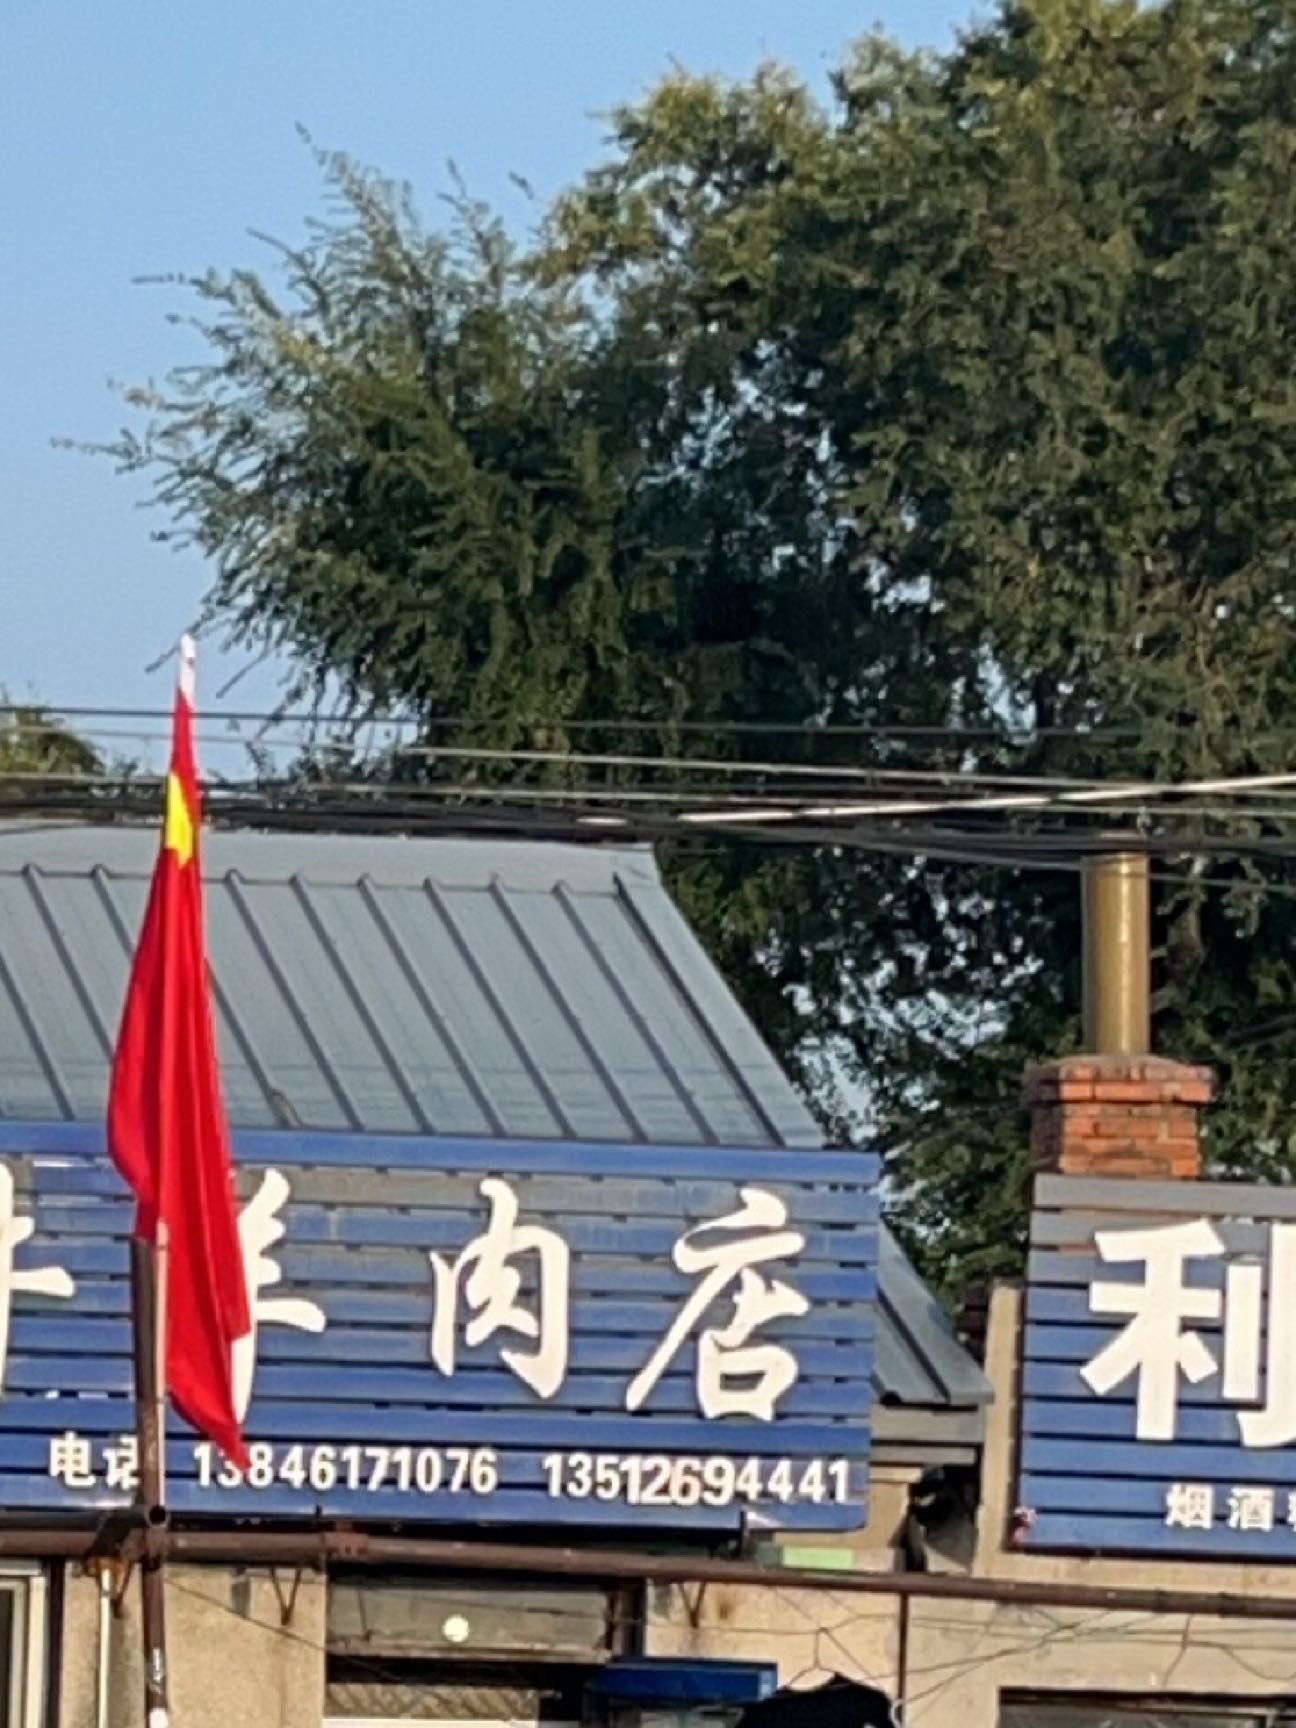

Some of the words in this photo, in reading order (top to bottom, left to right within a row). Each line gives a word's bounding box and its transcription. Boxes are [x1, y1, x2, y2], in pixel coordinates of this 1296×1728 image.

[1080, 1219, 1296, 1447] 利
[542, 1453, 849, 1505] 13512694441
[1165, 1483, 1296, 1532] 烟酒
